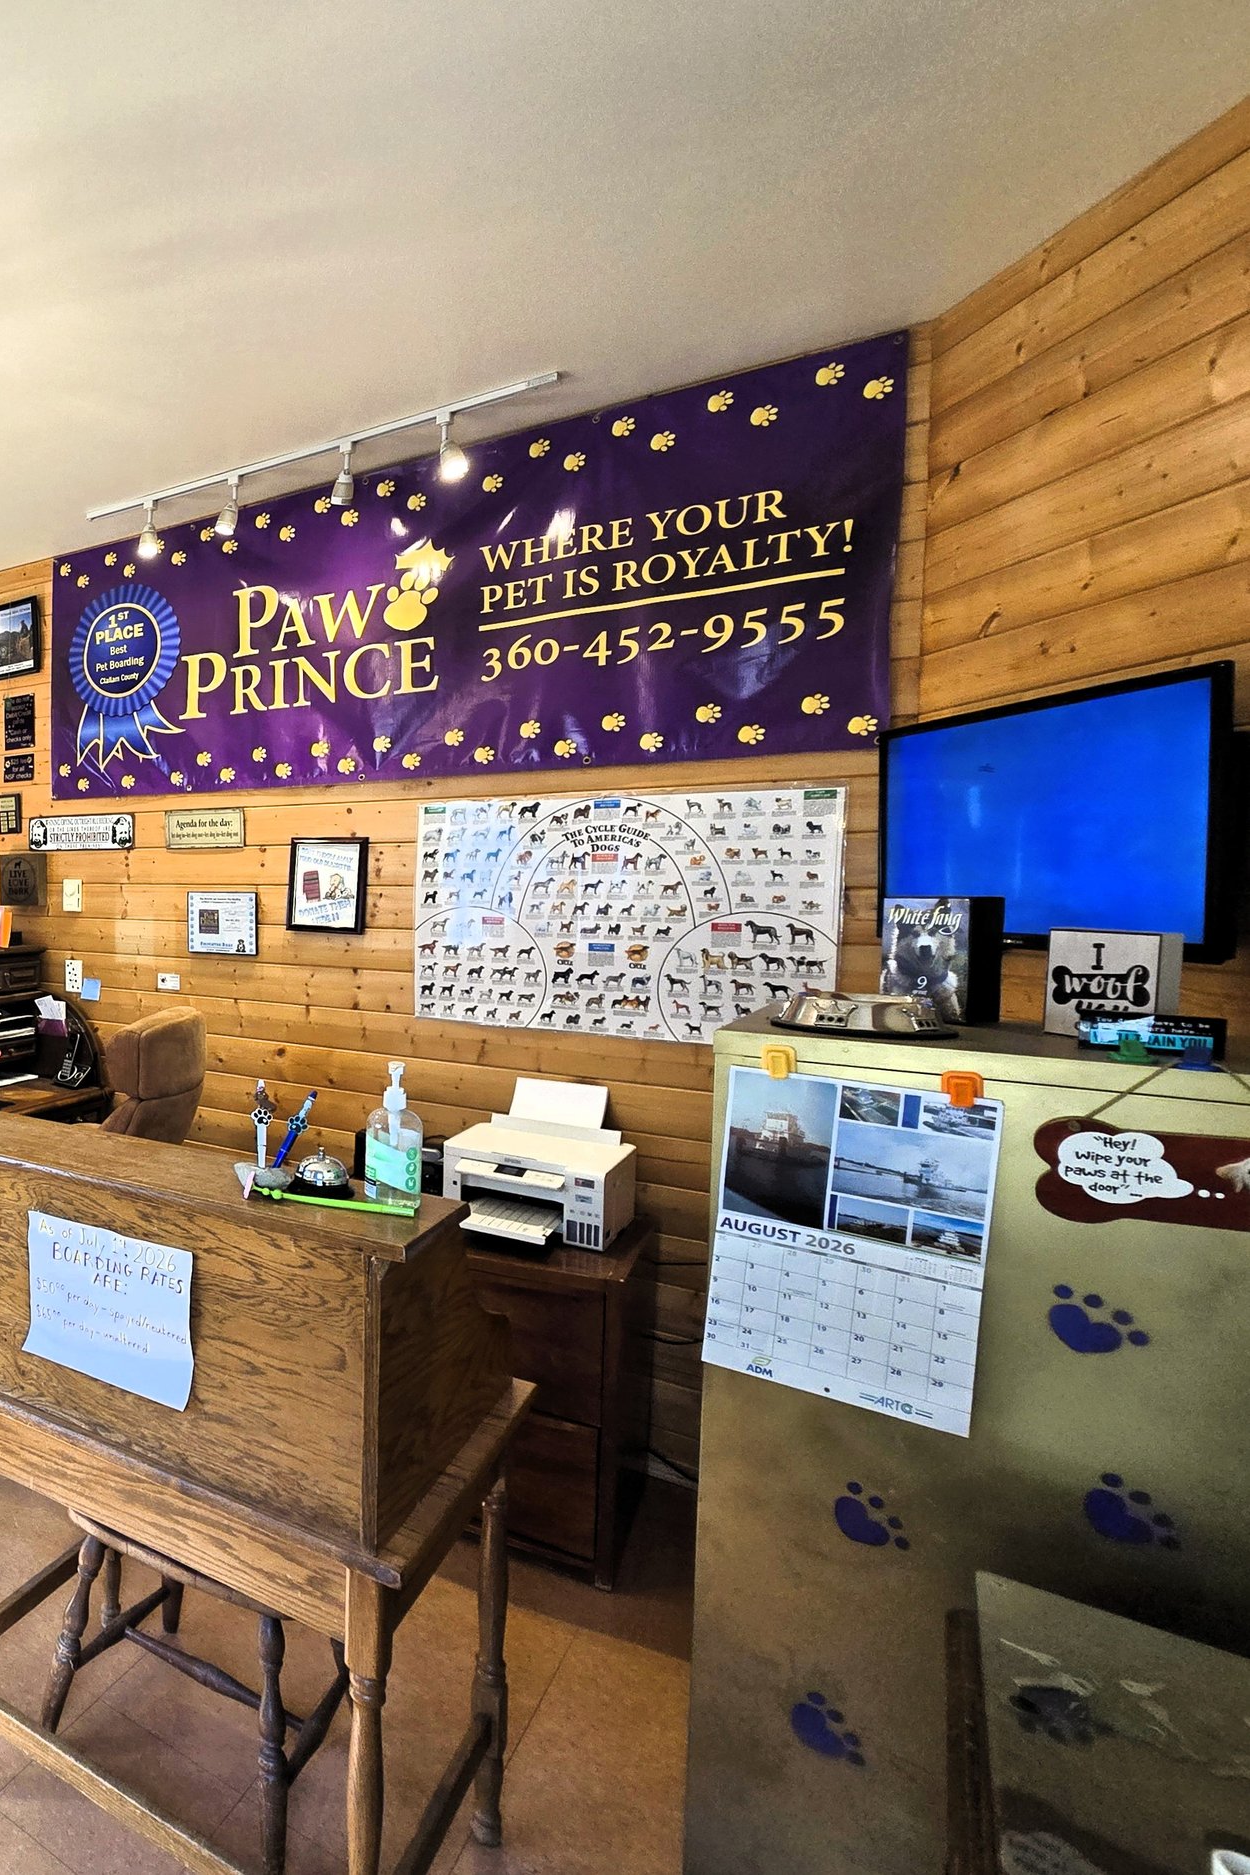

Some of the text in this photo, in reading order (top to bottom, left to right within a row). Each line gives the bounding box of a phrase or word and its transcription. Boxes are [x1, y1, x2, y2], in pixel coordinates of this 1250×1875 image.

[479, 489, 788, 573] WHERE YOUR
[480, 518, 855, 614] PET IS ROYALTY!
[108, 611, 130, 629] 1ST
[232, 582, 386, 659] PAW
[95, 622, 145, 645] PLACE
[480, 597, 847, 682] 360-452-9555
[110, 644, 128, 656] Best
[96, 655, 145, 673] Pet Boarding
[120, 672, 140, 682] County
[178, 635, 440, 721] PRINCE
[176, 818, 233, 831] Agenda for the day:
[562, 823, 651, 841] THE CYCLE GUIDE
[49, 831, 110, 843] STRICTLY PROHIBITED
[570, 834, 642, 848] TO AMERICA'S
[591, 843, 621, 852] DOGS
[9, 869, 27, 879] LIVE
[887, 907, 930, 926] White
[1091, 943, 1105, 970] I
[917, 975, 928, 990] 9
[1063, 966, 1144, 1001] woof
[1075, 1151, 1151, 1167] Wipe your
[1064, 1165, 1163, 1185] paws at the
[39, 1218, 54, 1235] As
[61, 1227, 73, 1239] of
[79, 1227, 105, 1257] July
[133, 1242, 177, 1273] 2026
[720, 1216, 855, 1256] AUGUST 2026
[52, 1241, 184, 1295] BOARDING RATES
[861, 1266, 872, 1274] 30
[93, 1272, 128, 1295] ARE:
[67, 1291, 81, 1303] per
[84, 1295, 100, 1315] day
[713, 1275, 948, 1341] 9 10 11 12 13 14 15
[858, 1288, 864, 1296] 6
[939, 1308, 945, 1316] 8
[63, 1319, 76, 1331] per
[78, 1321, 94, 1340] day
[711, 1297, 720, 1305] 16
[780, 1315, 790, 1323] 18
[817, 1324, 827, 1332] 19
[853, 1334, 865, 1342] 20
[893, 1344, 903, 1353] 21
[933, 1356, 946, 1365] 22
[706, 1332, 750, 1349] 30 31
[707, 1318, 944, 1388] 23 24 25 26 27 28 29
[746, 1364, 773, 1378] ADM
